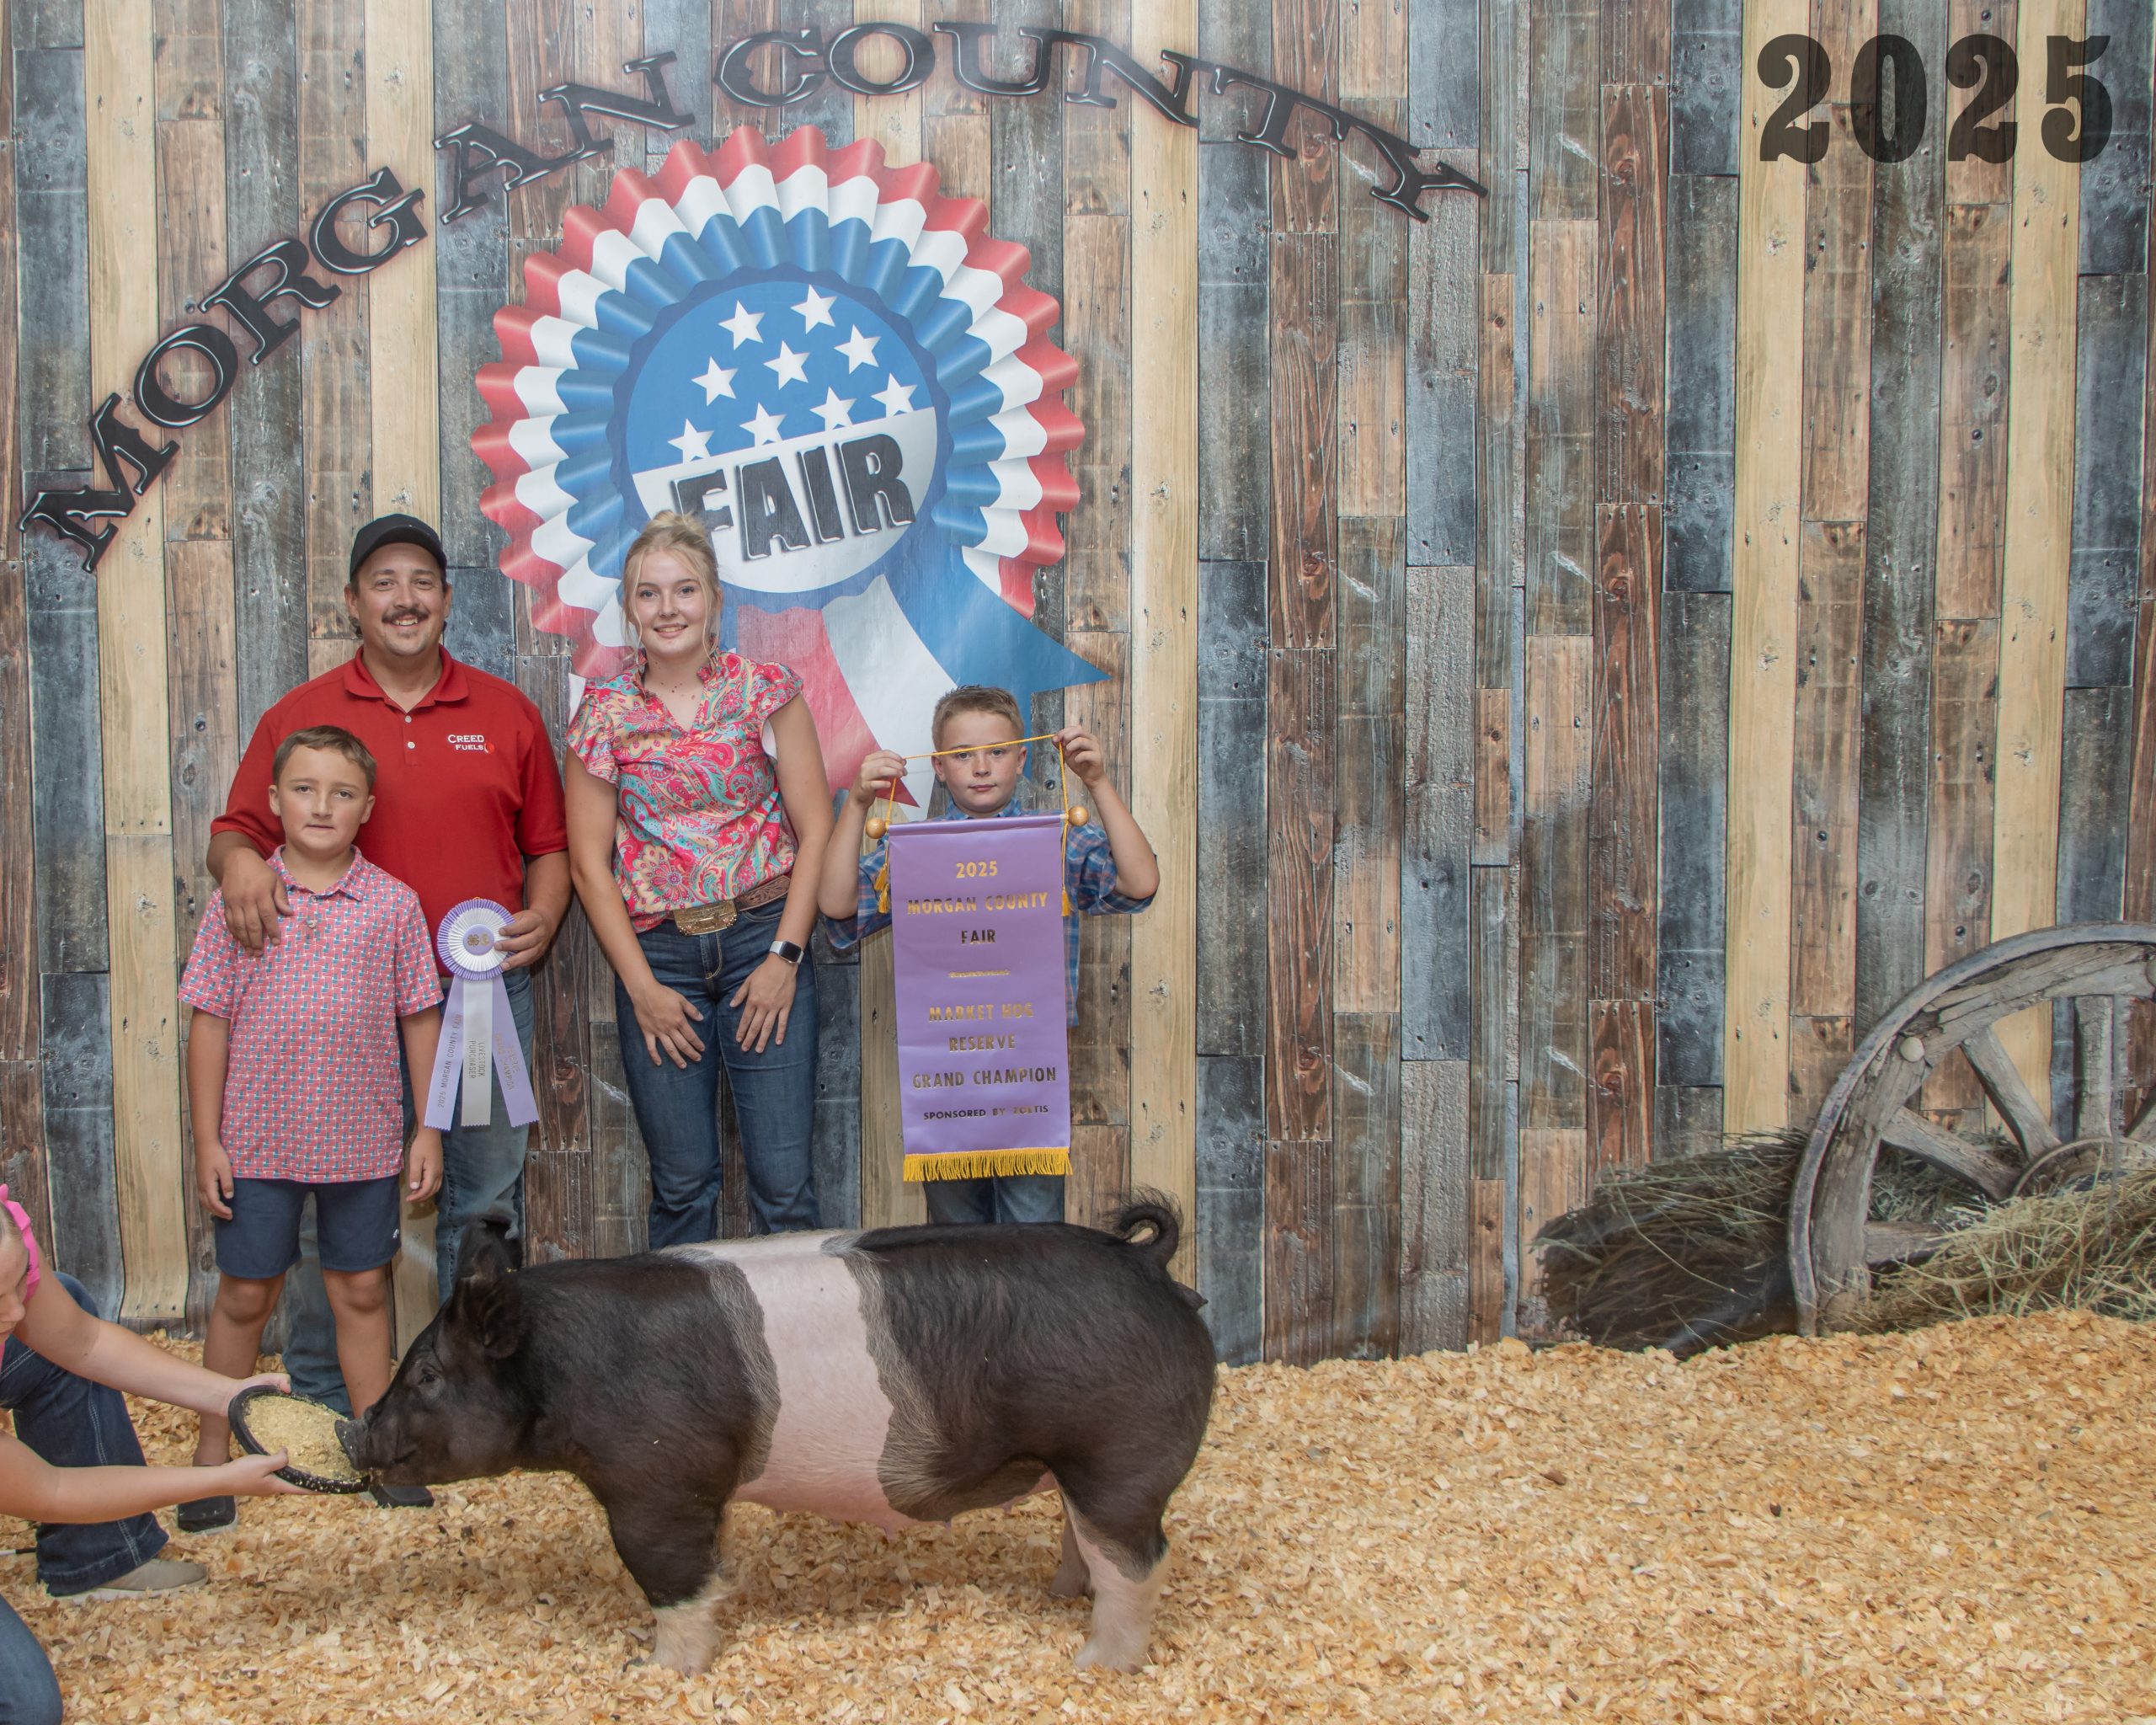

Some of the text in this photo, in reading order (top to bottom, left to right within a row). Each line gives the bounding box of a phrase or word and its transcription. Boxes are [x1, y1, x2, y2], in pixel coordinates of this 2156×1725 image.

[15, 21, 1488, 574] MORGAN COUNTY
[670, 434, 916, 562] FAIR
[447, 734, 485, 743] CREED
[956, 861, 998, 878] 2025
[907, 892, 1048, 915] MORGAN COUNTY
[961, 929, 995, 945] FAIR
[929, 1002, 1034, 1022] MARKET HOG
[948, 1034, 1016, 1052] RESERVE
[441, 1060, 451, 1088] MORGAN
[447, 1032, 458, 1058] COUNTY
[913, 1066, 1056, 1089] GRAND CHAMPION
[924, 1105, 1049, 1120] SPONSORED BY ZOETIS
